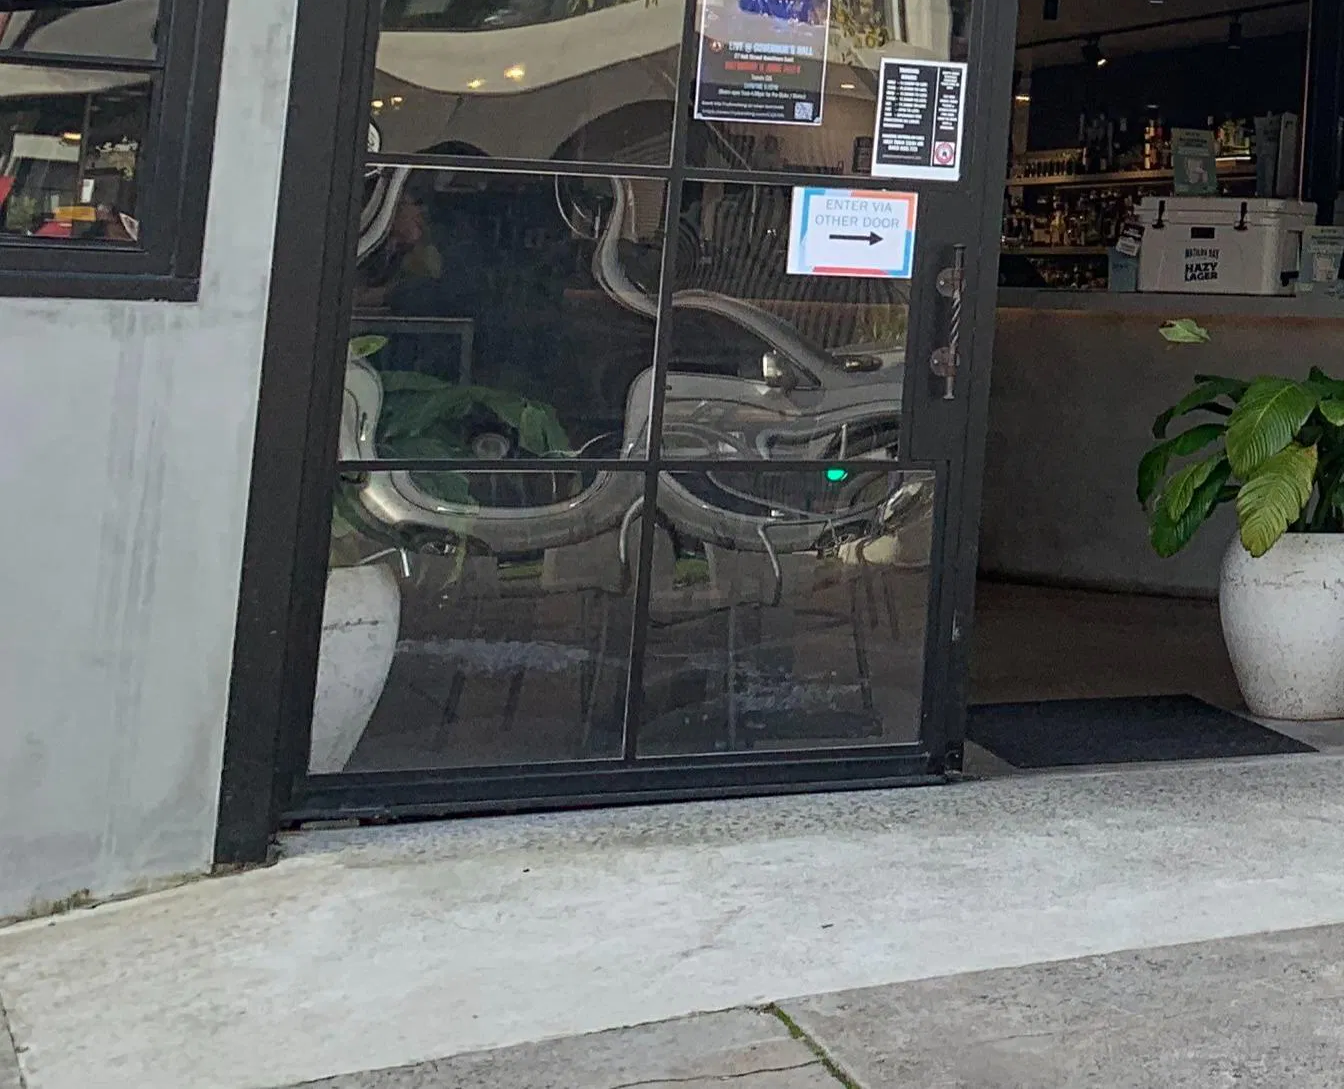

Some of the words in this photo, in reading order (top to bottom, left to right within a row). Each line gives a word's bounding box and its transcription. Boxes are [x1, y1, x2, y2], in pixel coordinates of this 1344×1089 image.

[826, 198, 868, 211] ENTER
[872, 202, 893, 213] VIA
[815, 214, 858, 227] OTHER
[863, 217, 900, 229] DOOR
[1184, 262, 1218, 273] HAZY
[1184, 272, 1218, 282] LAGER
